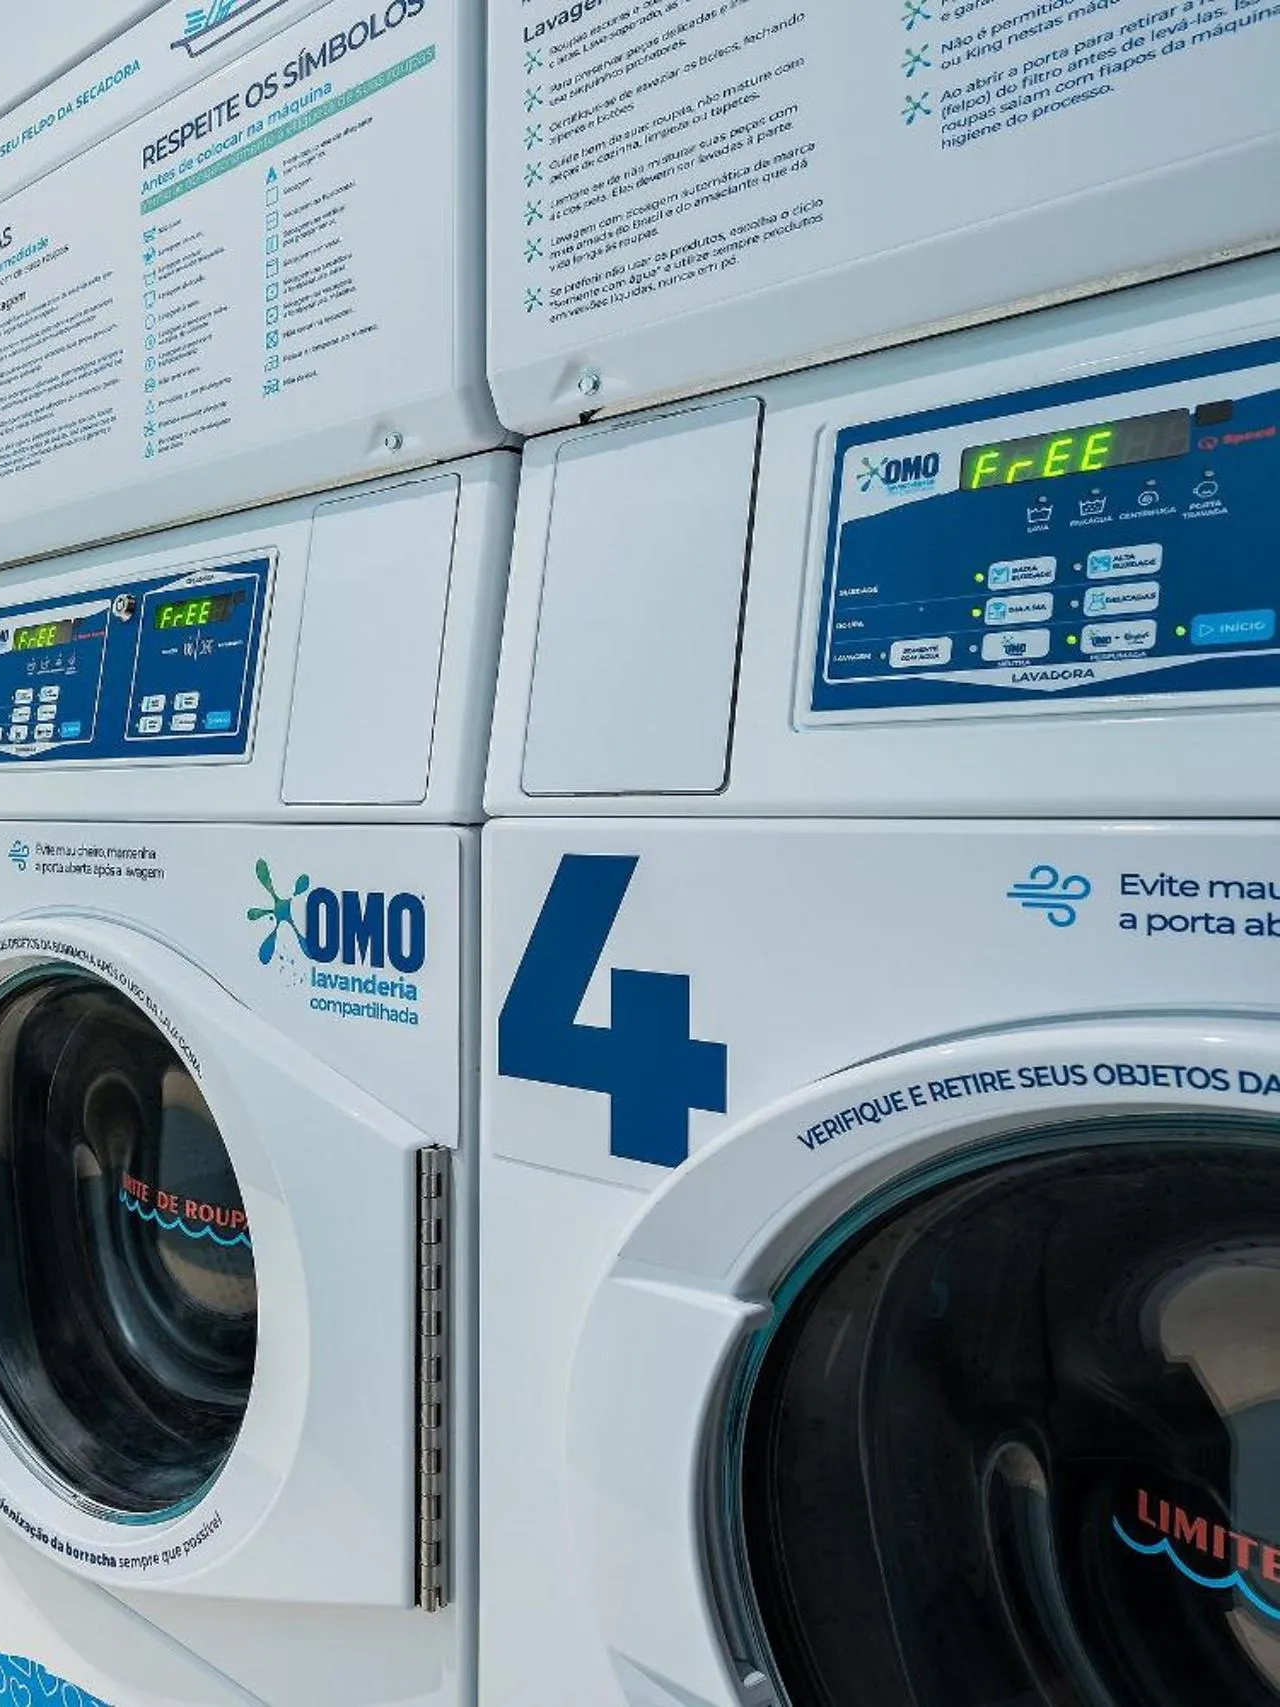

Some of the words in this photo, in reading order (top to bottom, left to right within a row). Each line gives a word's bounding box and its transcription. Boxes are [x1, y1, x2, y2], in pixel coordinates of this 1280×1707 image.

[523, 0, 603, 43] Lavage
[743, 10, 805, 45] fechando
[939, 86, 961, 102] Ao
[966, 70, 1004, 92] abrir
[1023, 45, 1069, 73] porta
[1074, 30, 1113, 54] para
[1120, 4, 1177, 35] retirar
[940, 55, 961, 69] ou
[965, 37, 1002, 62] King
[1007, 13, 1063, 43] nestas
[941, 32, 973, 53] Não
[774, 57, 804, 75] com
[941, 91, 990, 119] (felpo)
[995, 81, 1017, 98] do
[1021, 64, 1062, 88] filtro
[1067, 44, 1116, 72] antes
[1121, 34, 1145, 52] de
[1151, 4, 1227, 41] levá-las.
[941, 106, 995, 135] roupas
[999, 85, 1049, 112] saiam
[1055, 71, 1093, 92] com
[1099, 46, 1156, 79] fiapos
[1161, 36, 1185, 55] da
[1192, 2, 1280, 46] máquina
[142, 94, 240, 169] RESPEITE
[245, 72, 278, 109] OS
[282, 0, 424, 89] SÍMBOLOS
[0, 137, 17, 157] SEU
[21, 112, 54, 143] FELPO
[57, 99, 73, 119] DA
[76, 54, 141, 107] SECADORA
[768, 104, 798, 121] com
[940, 119, 1001, 151] higiene
[1006, 110, 1028, 126] do
[1032, 81, 1115, 119] processo.
[141, 167, 173, 193] Antes
[197, 129, 243, 163] colocar
[247, 122, 263, 135] na
[268, 79, 332, 126] máquina
[680, 164, 750, 197] automática
[772, 142, 815, 163] marca
[761, 167, 787, 184] que
[791, 157, 808, 170] dá
[670, 230, 725, 258] produtos,
[792, 196, 823, 214] ciclo
[762, 212, 823, 241] produtos
[884, 452, 940, 484] OMO
[970, 430, 1112, 489] FrEE
[160, 602, 212, 629] FrEE
[1105, 592, 1156, 603] DELICADAS
[1221, 621, 1266, 632] INÍCIO
[1011, 667, 1095, 683] LAVADORA
[42, 862, 64, 875] porta
[65, 861, 93, 875] aberta
[93, 863, 115, 878] após
[107, 846, 156, 860] mantenha
[1120, 872, 1200, 897] Evite
[1209, 880, 1280, 900] mau
[305, 887, 426, 973] OMO
[1119, 912, 1137, 930] a
[1147, 913, 1235, 936] porta
[311, 966, 418, 1001] lavanderia
[310, 997, 419, 1026] compartilhada
[497, 853, 728, 1168] 4
[797, 1090, 908, 1150] VERIFIQUE
[907, 1085, 927, 1107] E
[928, 1070, 1015, 1102] RETIRE
[1017, 1064, 1088, 1088] SEUS
[1093, 1063, 1230, 1092] OBJETOS
[1239, 1070, 1280, 1095] DA
[157, 1191, 179, 1214] DE
[185, 1200, 248, 1229] ROUP
[50, 1536, 64, 1553] da
[66, 1542, 117, 1568] borracha
[119, 1553, 160, 1571] sempre
[162, 1545, 182, 1565] que
[182, 1510, 223, 1557] possível
[1137, 1488, 1280, 1584] LIMITE
